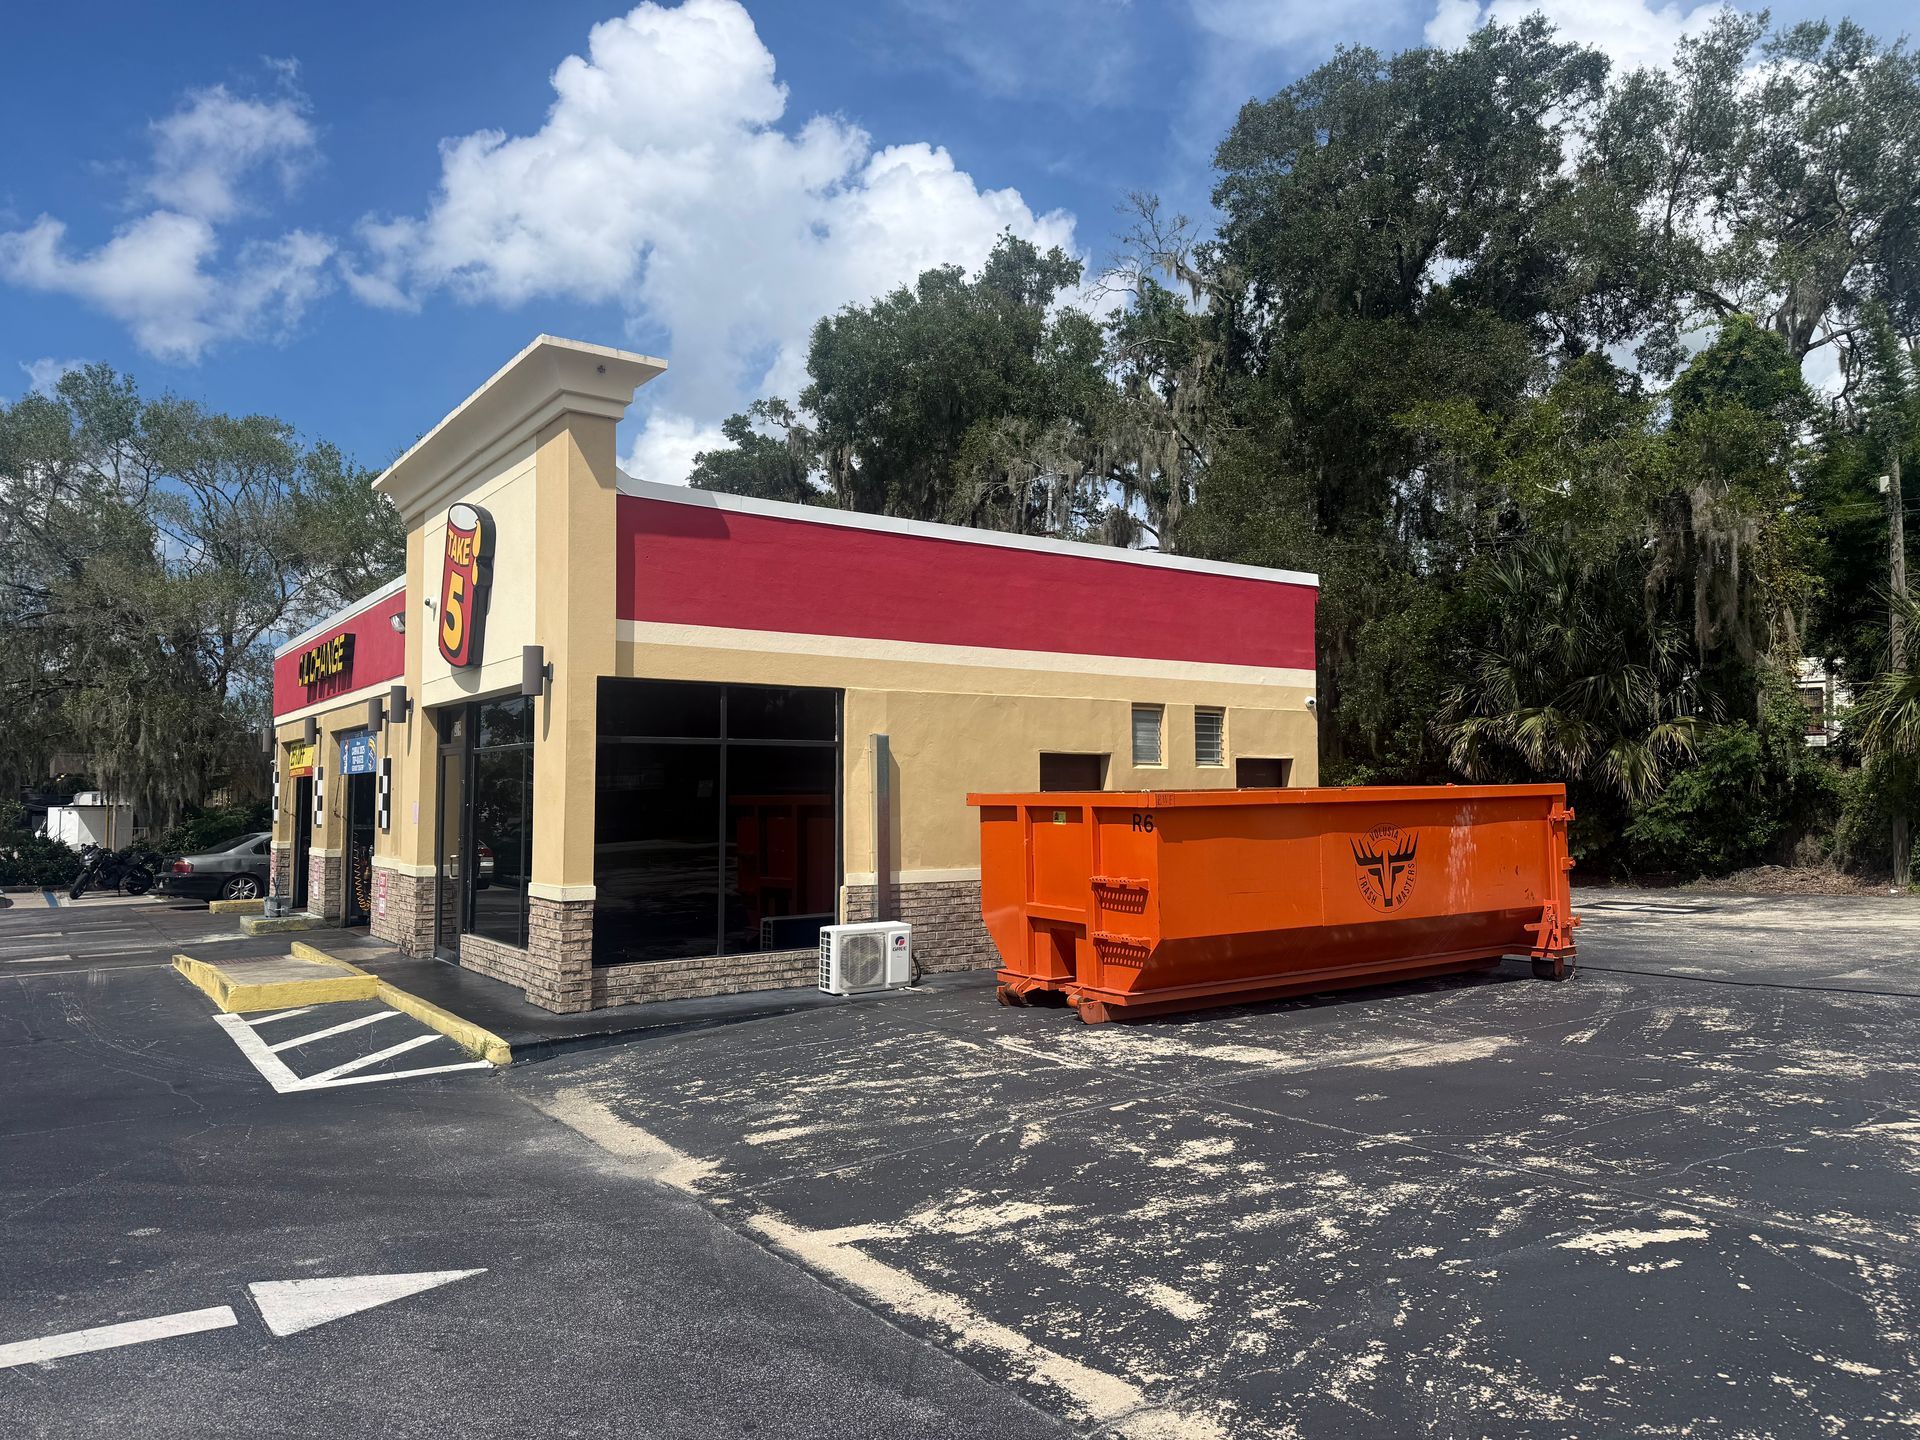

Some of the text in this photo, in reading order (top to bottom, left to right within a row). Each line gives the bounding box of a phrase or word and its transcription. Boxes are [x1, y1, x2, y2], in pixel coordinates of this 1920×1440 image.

[447, 528, 472, 566] TAKE
[442, 570, 465, 657] 5
[309, 633, 346, 683] CHANGE
[1132, 813, 1154, 833] R6
[1369, 826, 1399, 842] VOLUSIA
[1359, 863, 1415, 906] TRASH MASTERS
